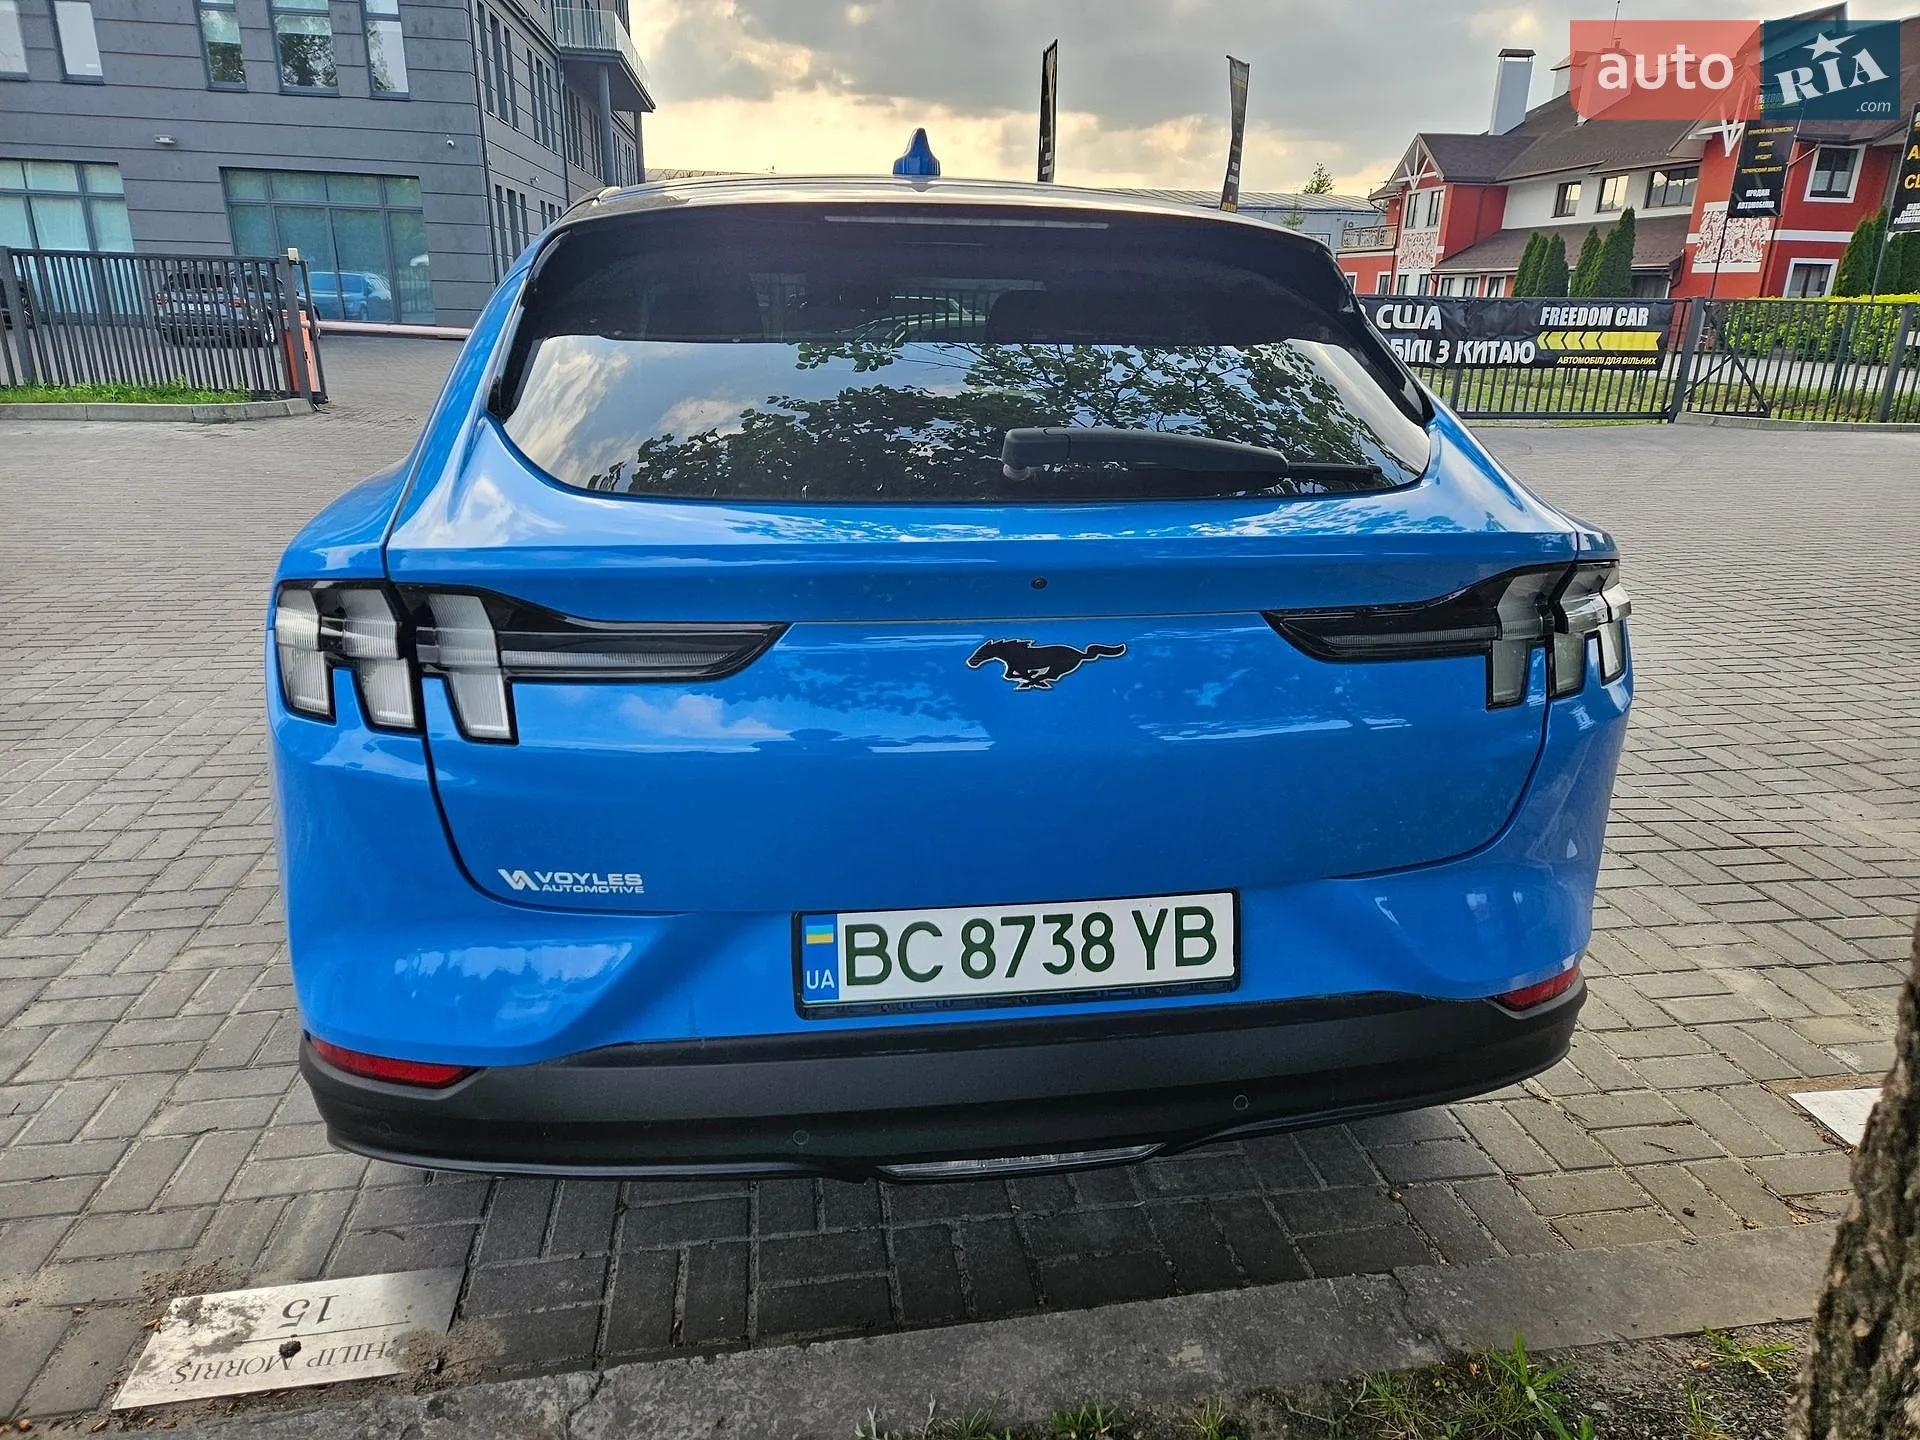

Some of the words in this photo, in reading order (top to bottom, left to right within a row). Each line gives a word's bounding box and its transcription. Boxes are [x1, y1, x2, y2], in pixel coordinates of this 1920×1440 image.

[1376, 304, 1442, 330] США
[1540, 306, 1614, 327] FREEDOM
[1615, 307, 1649, 327] CAR
[1455, 340, 1536, 365] КИТАЮ
[1556, 356, 1605, 365] АВТОМОБІЛІ
[1603, 356, 1622, 366] ДЛЯ
[1621, 356, 1657, 366] ВІЛЬНИХ
[533, 871, 643, 886] VOYLES
[541, 884, 645, 894] AUTOMOTIVE
[844, 921, 943, 986] BC
[960, 912, 1115, 980] 8738
[1131, 906, 1217, 971] YB
[806, 969, 835, 990] UA
[277, 1294, 339, 1329] 15
[170, 1352, 294, 1385] MORRIS
